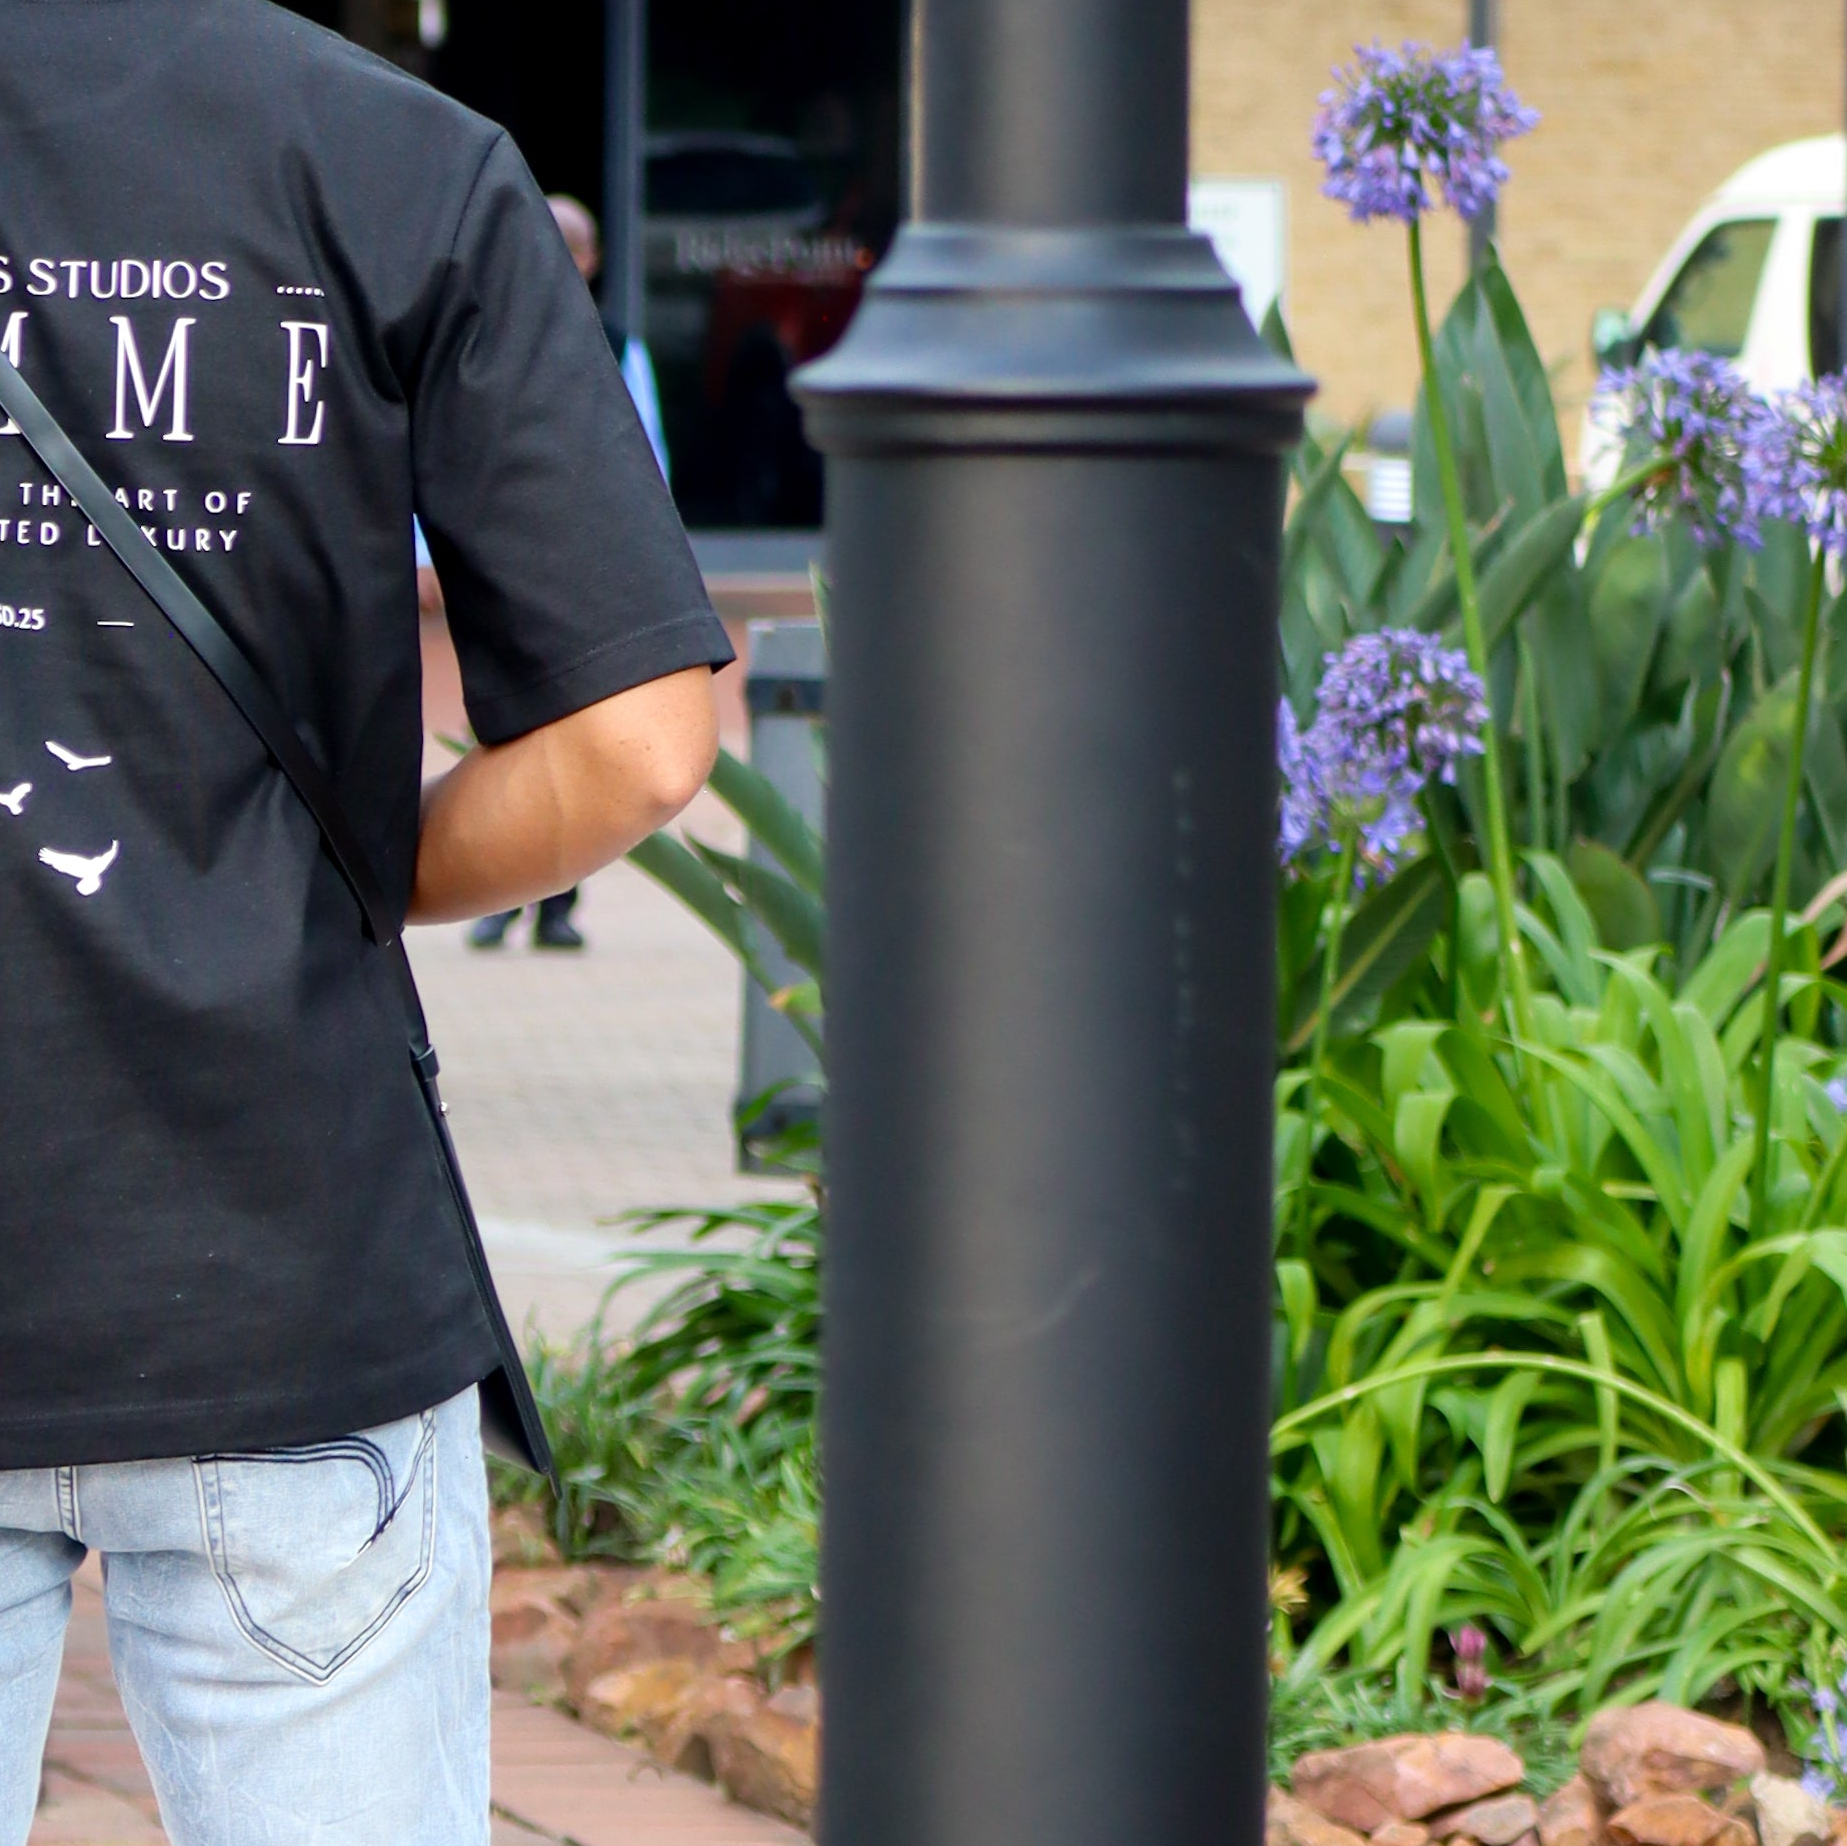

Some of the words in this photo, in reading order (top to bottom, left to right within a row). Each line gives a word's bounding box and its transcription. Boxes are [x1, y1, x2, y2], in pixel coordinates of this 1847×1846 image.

[26, 258, 230, 300] STUDIOS
[19, 482, 81, 507] TH
[114, 487, 178, 511] ART
[204, 491, 252, 514] OF
[87, 524, 238, 552] LXURY
